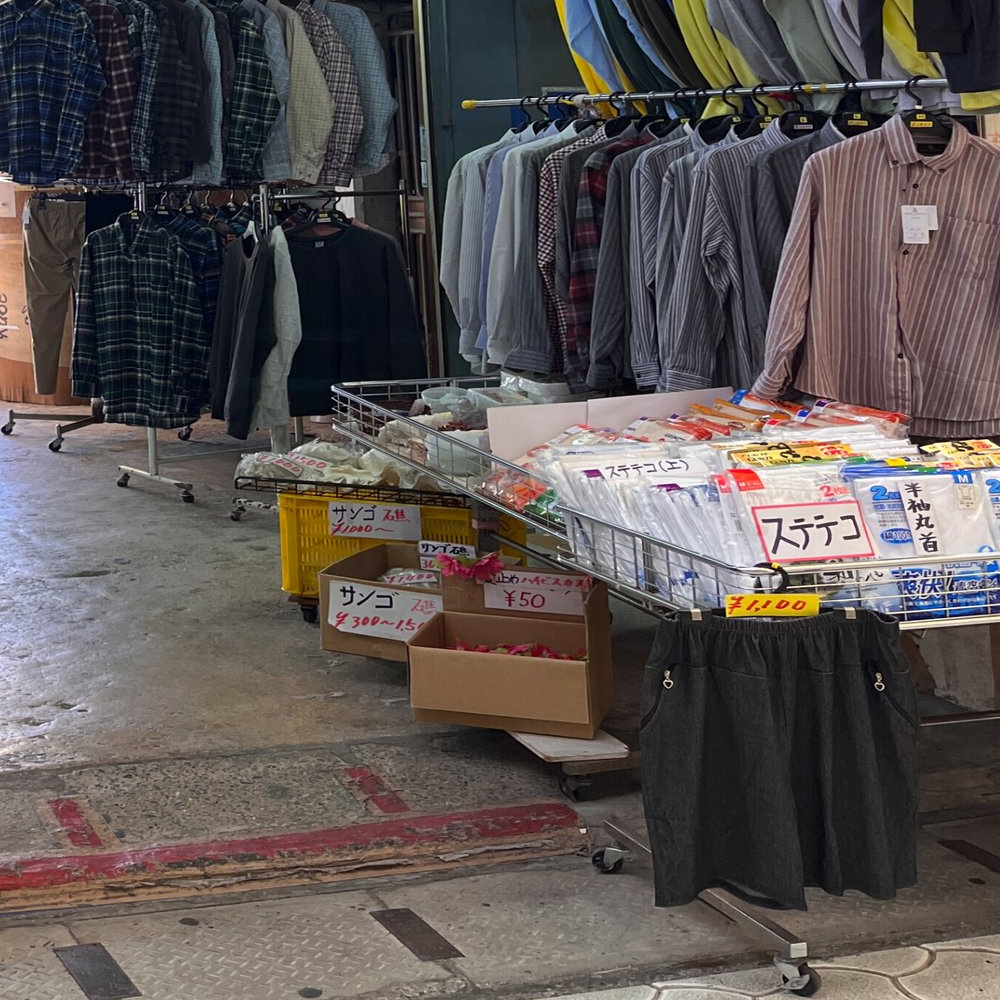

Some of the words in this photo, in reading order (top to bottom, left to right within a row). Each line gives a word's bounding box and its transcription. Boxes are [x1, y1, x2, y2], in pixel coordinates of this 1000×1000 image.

[957, 474, 969, 483] M
[904, 482, 939, 553] 半袖丸首
[761, 514, 861, 555] ステテコ
[503, 589, 546, 609] ¥50
[727, 595, 807, 616] ¥1,100
